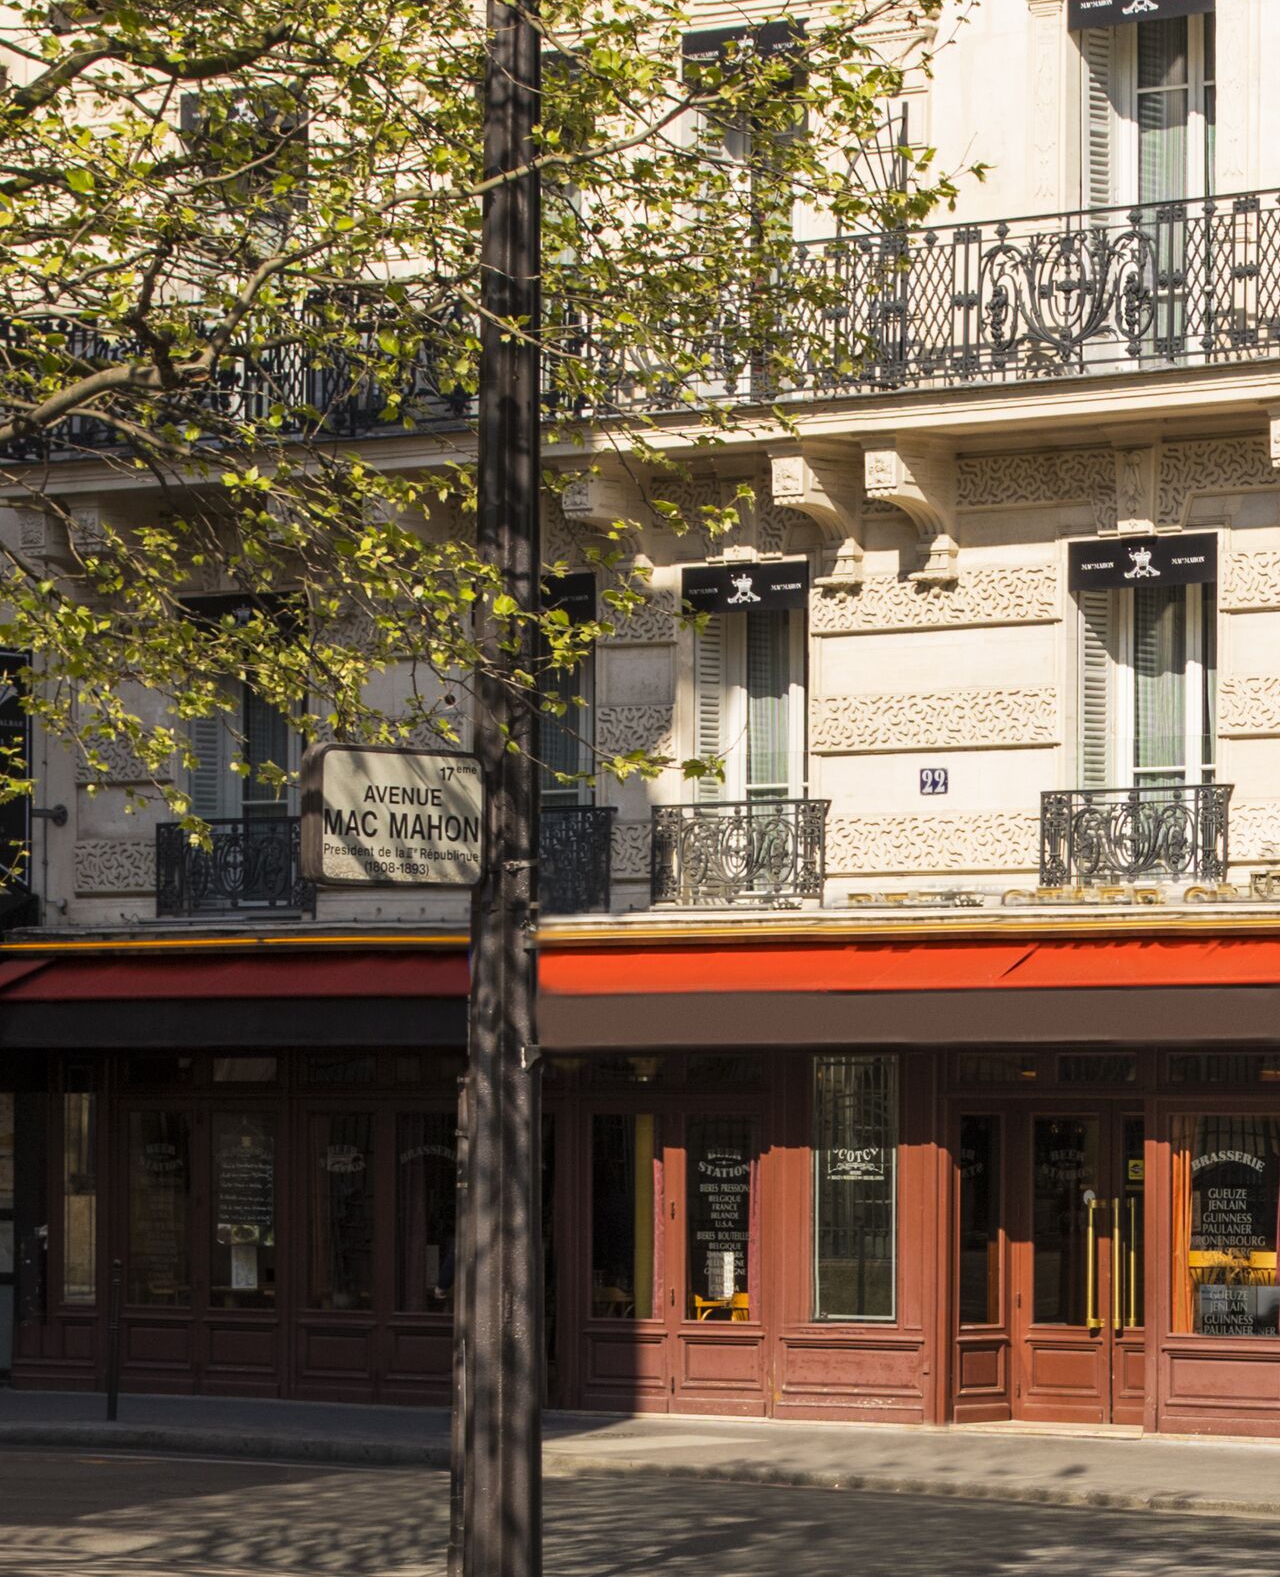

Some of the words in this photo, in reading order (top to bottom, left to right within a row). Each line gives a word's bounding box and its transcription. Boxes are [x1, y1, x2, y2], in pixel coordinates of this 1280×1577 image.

[921, 770, 946, 794] 22
[363, 785, 443, 807] AVENUE
[324, 808, 379, 838] MAC
[389, 811, 479, 843] MAHON
[378, 846, 392, 858] de
[395, 847, 405, 858] la
[420, 848, 479, 863] République
[364, 861, 430, 876] (1808-1893)
[1192, 1150, 1266, 1173] BRASSERIE
[698, 1161, 750, 1178] STATION
[1208, 1188, 1248, 1199] GUEUZE
[708, 1195, 742, 1204] BELGIQUE
[1208, 1199, 1247, 1211] JENLAIN
[712, 1203, 737, 1211] FRANCE
[711, 1212, 739, 1220] IRLANDE
[1202, 1212, 1253, 1223] GUINNESS
[1202, 1224, 1253, 1234] PAULANER
[709, 1242, 742, 1251] BELGIQUE
[1209, 1289, 1249, 1300] GUEUZE
[1210, 1302, 1248, 1313] JENLAIN
[1204, 1313, 1254, 1325] GUINNESS
[1203, 1325, 1254, 1336] PAULANER
